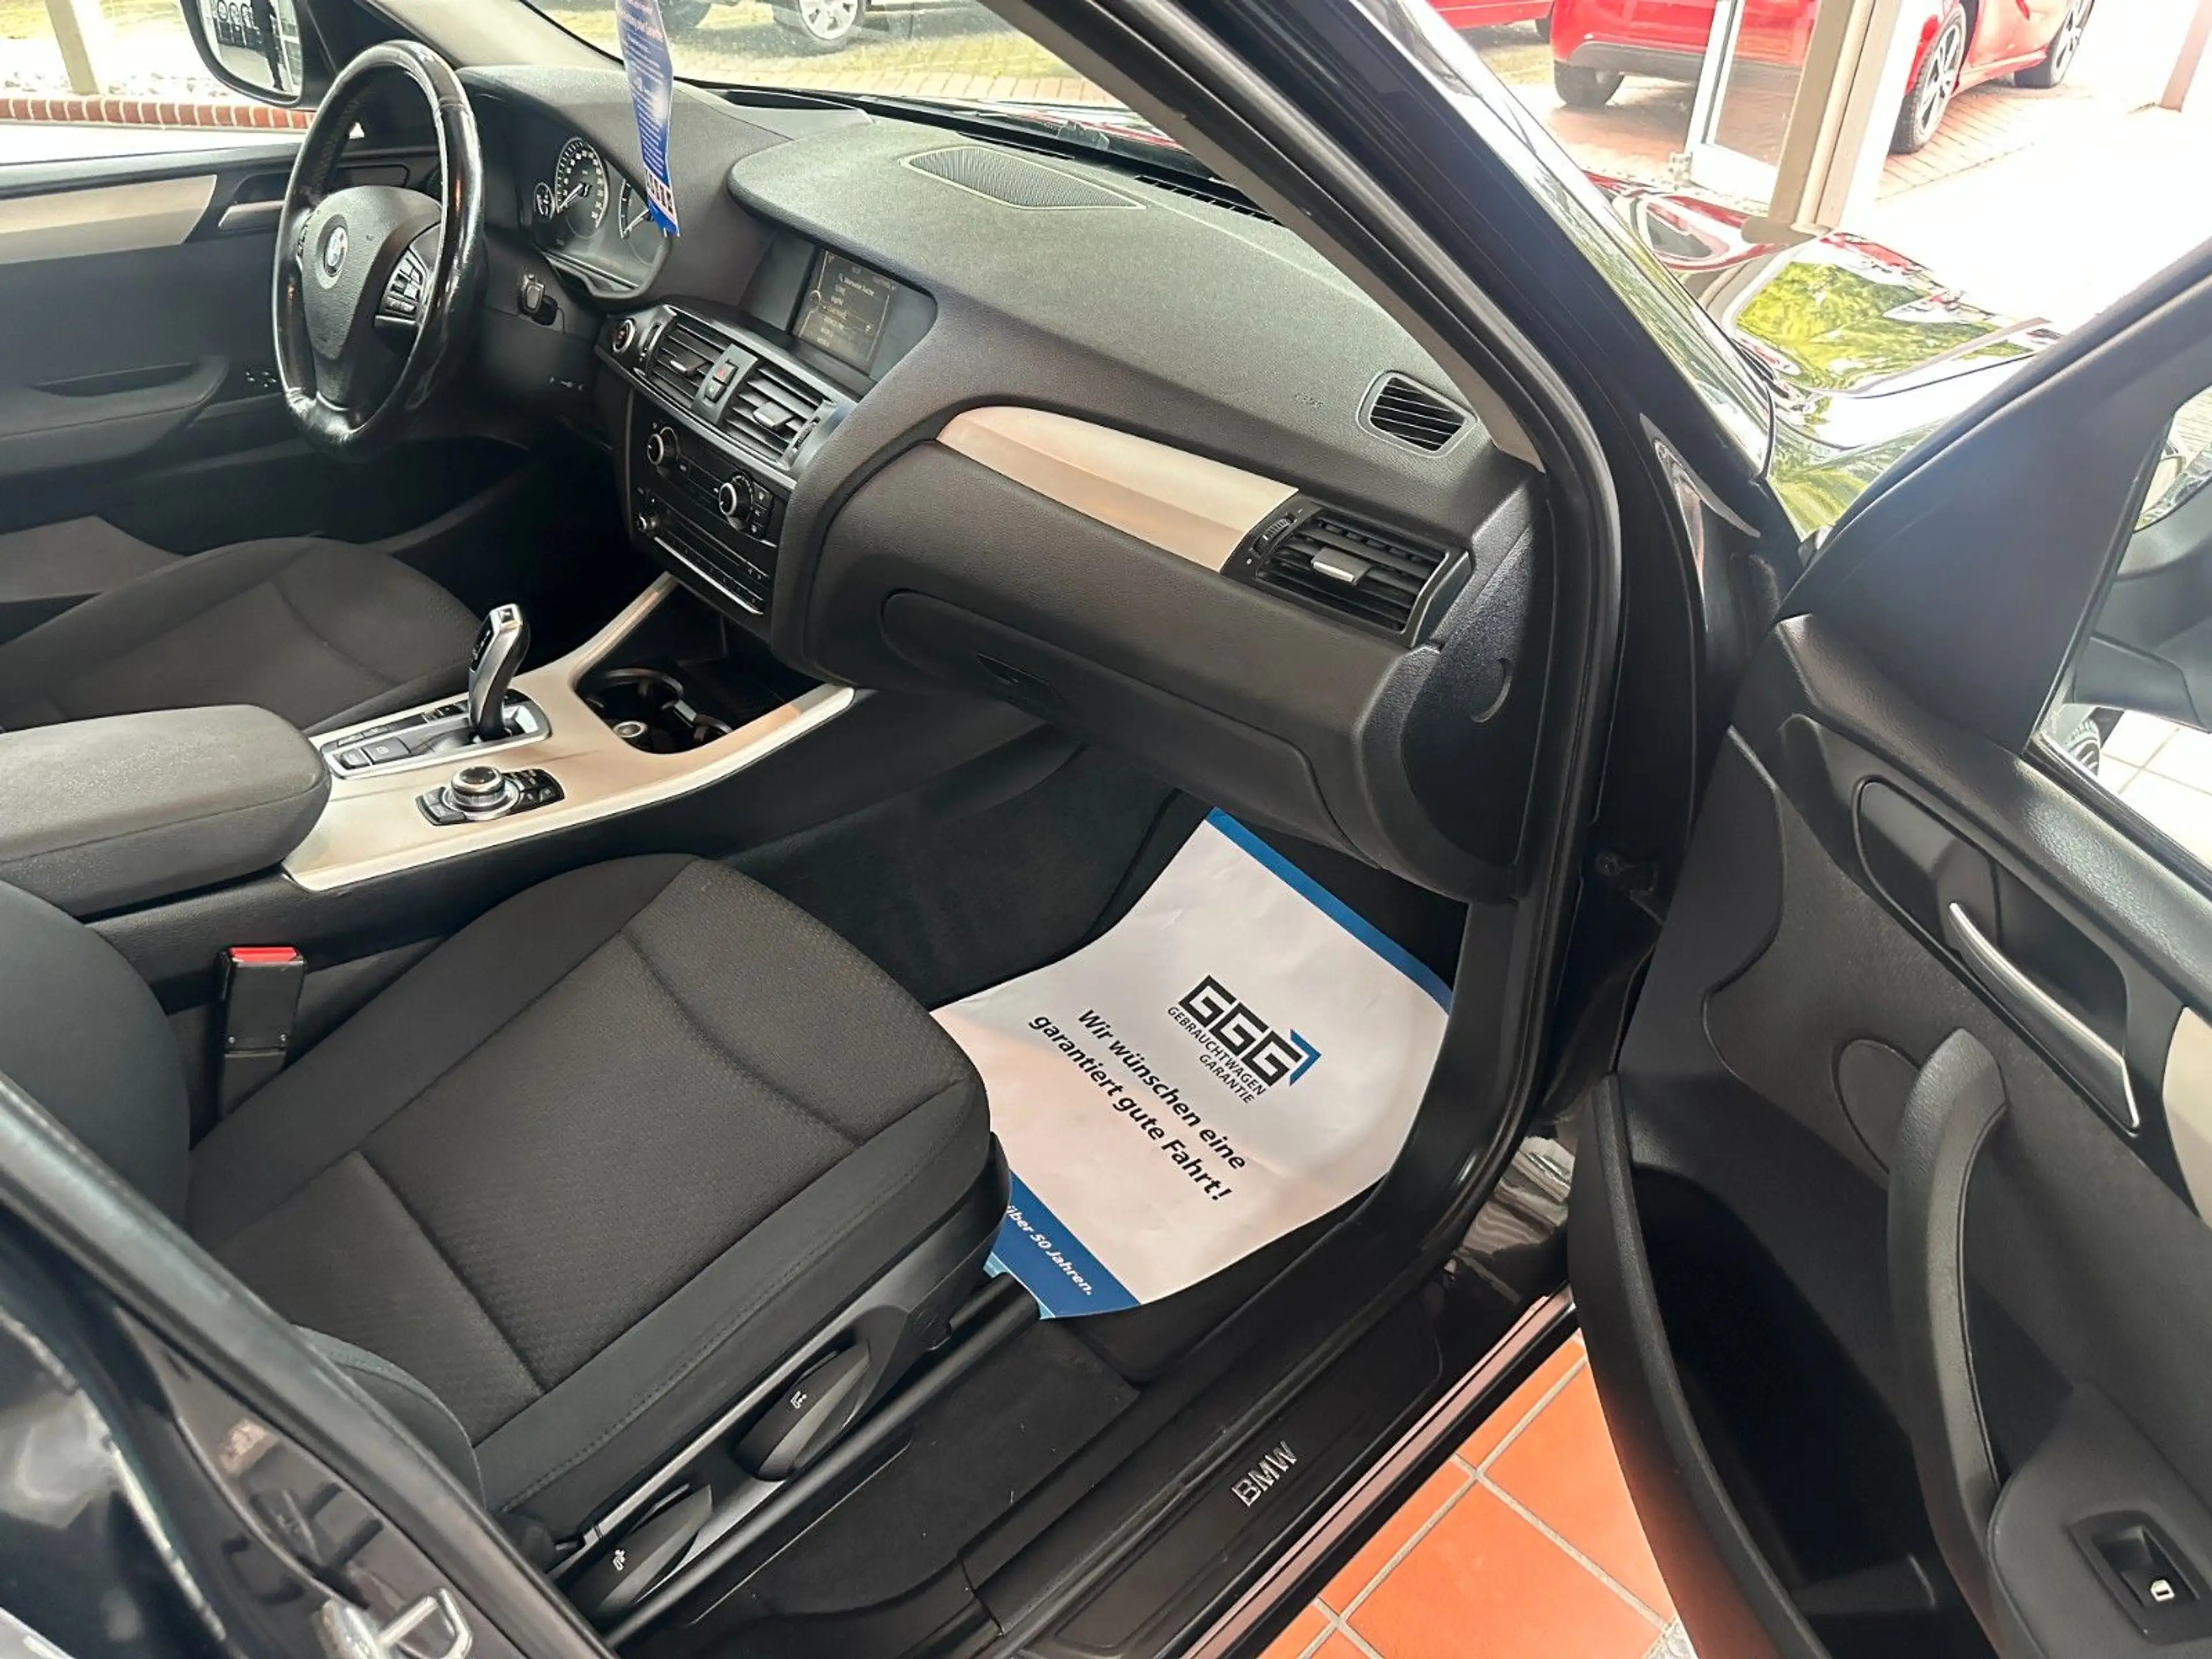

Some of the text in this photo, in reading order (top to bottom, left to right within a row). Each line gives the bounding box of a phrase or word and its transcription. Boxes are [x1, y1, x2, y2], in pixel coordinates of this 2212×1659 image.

[1168, 1006, 1266, 1095] GEBRAUCHTWAGEN
[1178, 975, 1302, 1088] GGG
[1028, 1016, 1232, 1200] garantiert gute Fahrt!
[1078, 1009, 1245, 1169] Wir wünschen eine
[1199, 1055, 1255, 1104] GARANTIE
[1030, 1233, 1052, 1249] 50
[1045, 1251, 1092, 1296] Jahren.
[1231, 1440, 1298, 1507] BMW
